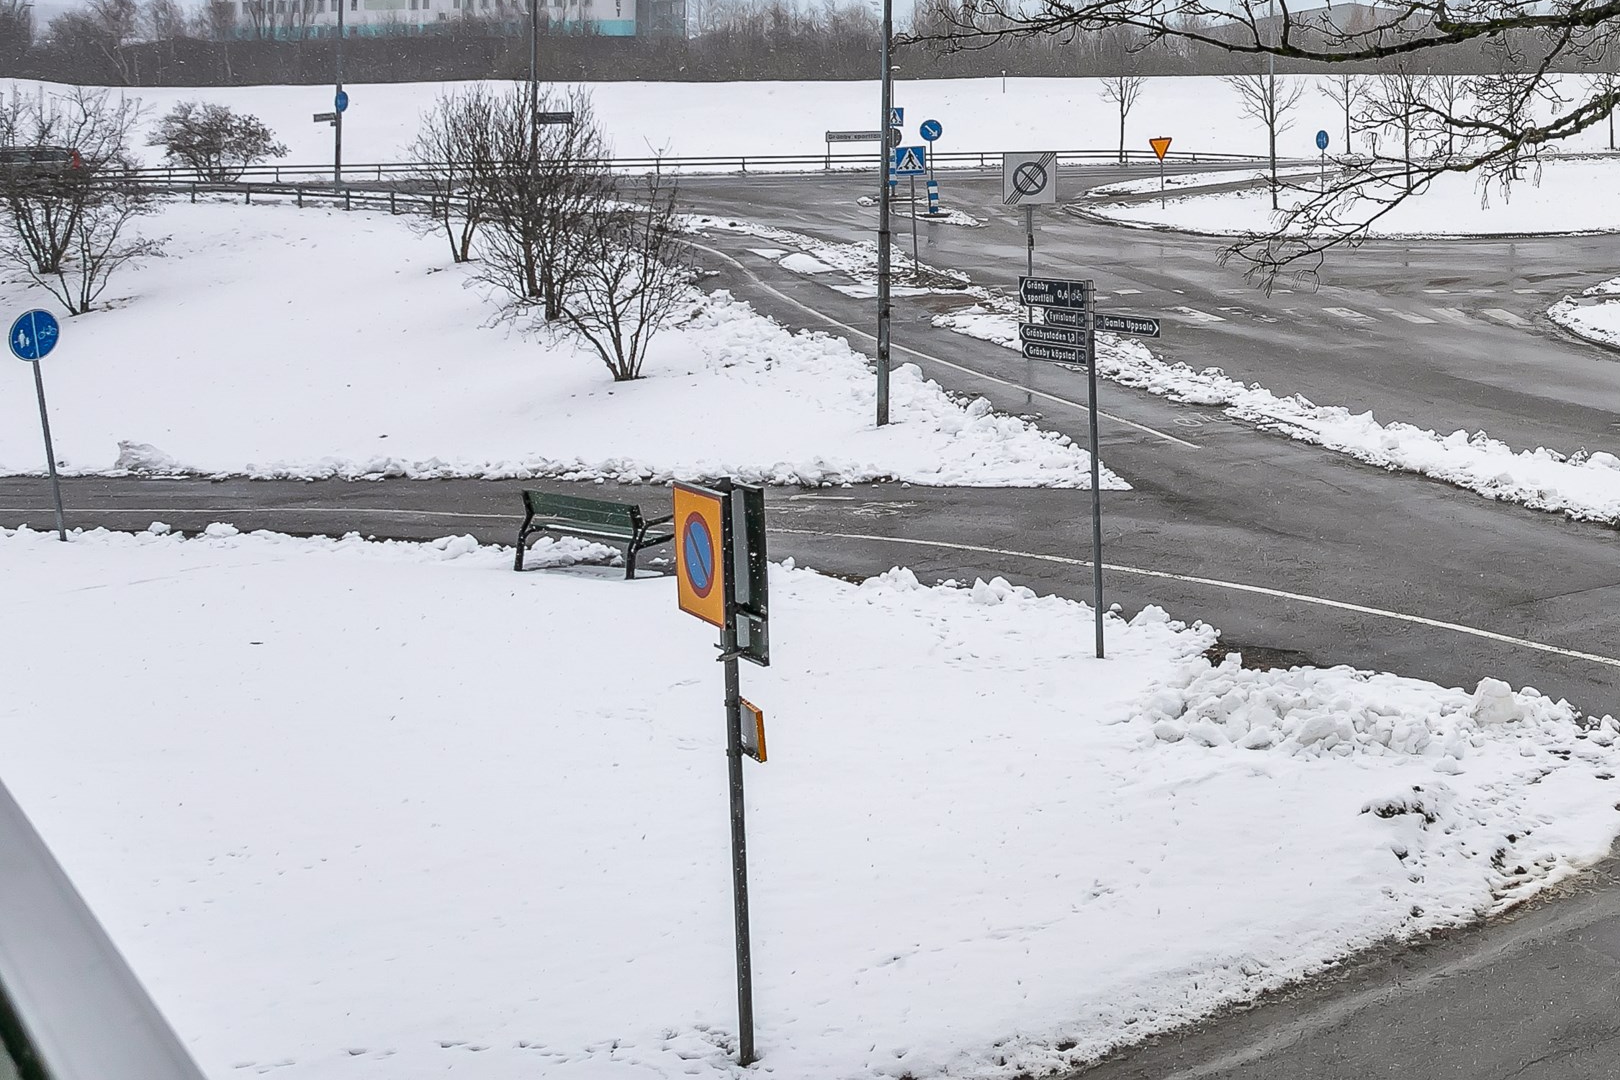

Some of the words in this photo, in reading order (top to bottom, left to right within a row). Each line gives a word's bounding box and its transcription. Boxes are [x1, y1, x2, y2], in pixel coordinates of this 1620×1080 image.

[1026, 280, 1049, 292] Gränby
[1027, 293, 1054, 303] sportfält
[1104, 317, 1125, 328] Gamla
[1126, 319, 1153, 332] Uppsala
[1029, 346, 1050, 358] Gränby
